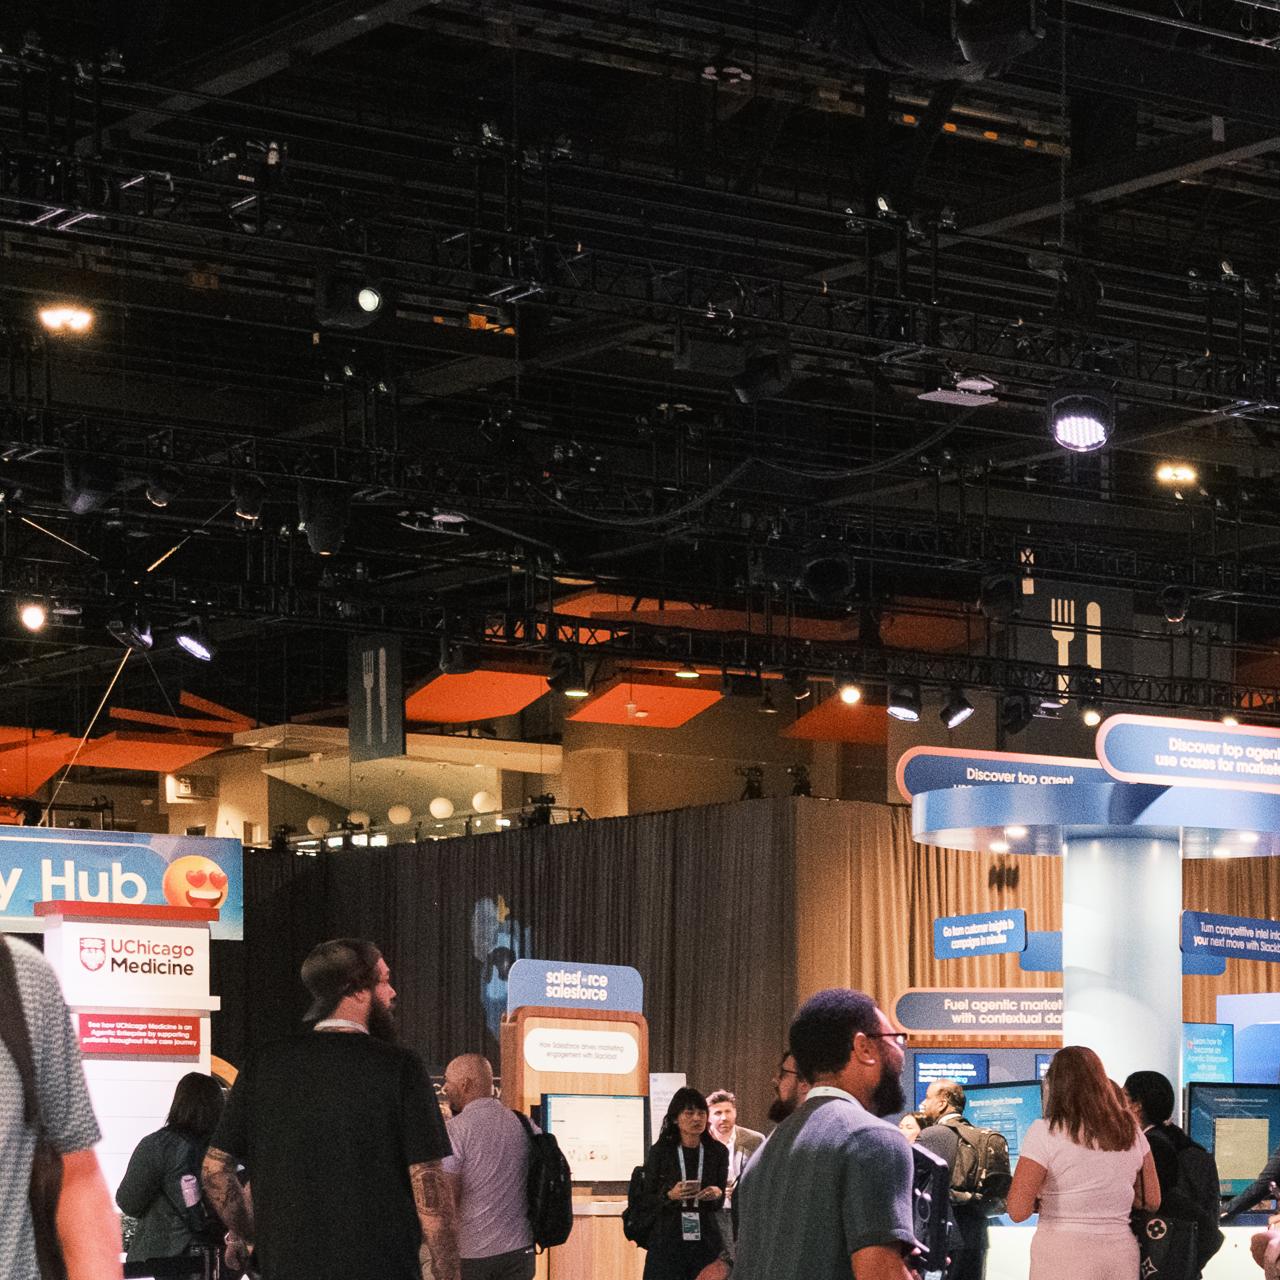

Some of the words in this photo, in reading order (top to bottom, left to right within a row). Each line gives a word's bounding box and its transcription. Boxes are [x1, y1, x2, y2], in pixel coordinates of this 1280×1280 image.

[1168, 737, 1222, 755] Discover
[1222, 742, 1244, 759] top
[1155, 754, 1178, 767] use
[1180, 756, 1217, 771] cases
[1217, 758, 1235, 772] for
[966, 767, 1016, 783] Discover
[1018, 771, 1038, 785] top
[41, 859, 148, 904] Hub
[1215, 925, 1254, 938] competitive
[1255, 928, 1268, 940] intel
[111, 939, 194, 960] UChicago
[1193, 935, 1209, 947] your
[1210, 937, 1225, 948] next
[1226, 939, 1245, 949] move
[1246, 940, 1259, 951] with
[111, 958, 194, 975] Medicine
[546, 984, 608, 1001] salesforce
[944, 999, 969, 1011] Fuel
[971, 999, 1018, 1013] agentic
[1020, 999, 1063, 1011] market
[952, 1012, 976, 1024] with
[979, 1012, 1042, 1024] contextual
[1045, 1013, 1063, 1024] da
